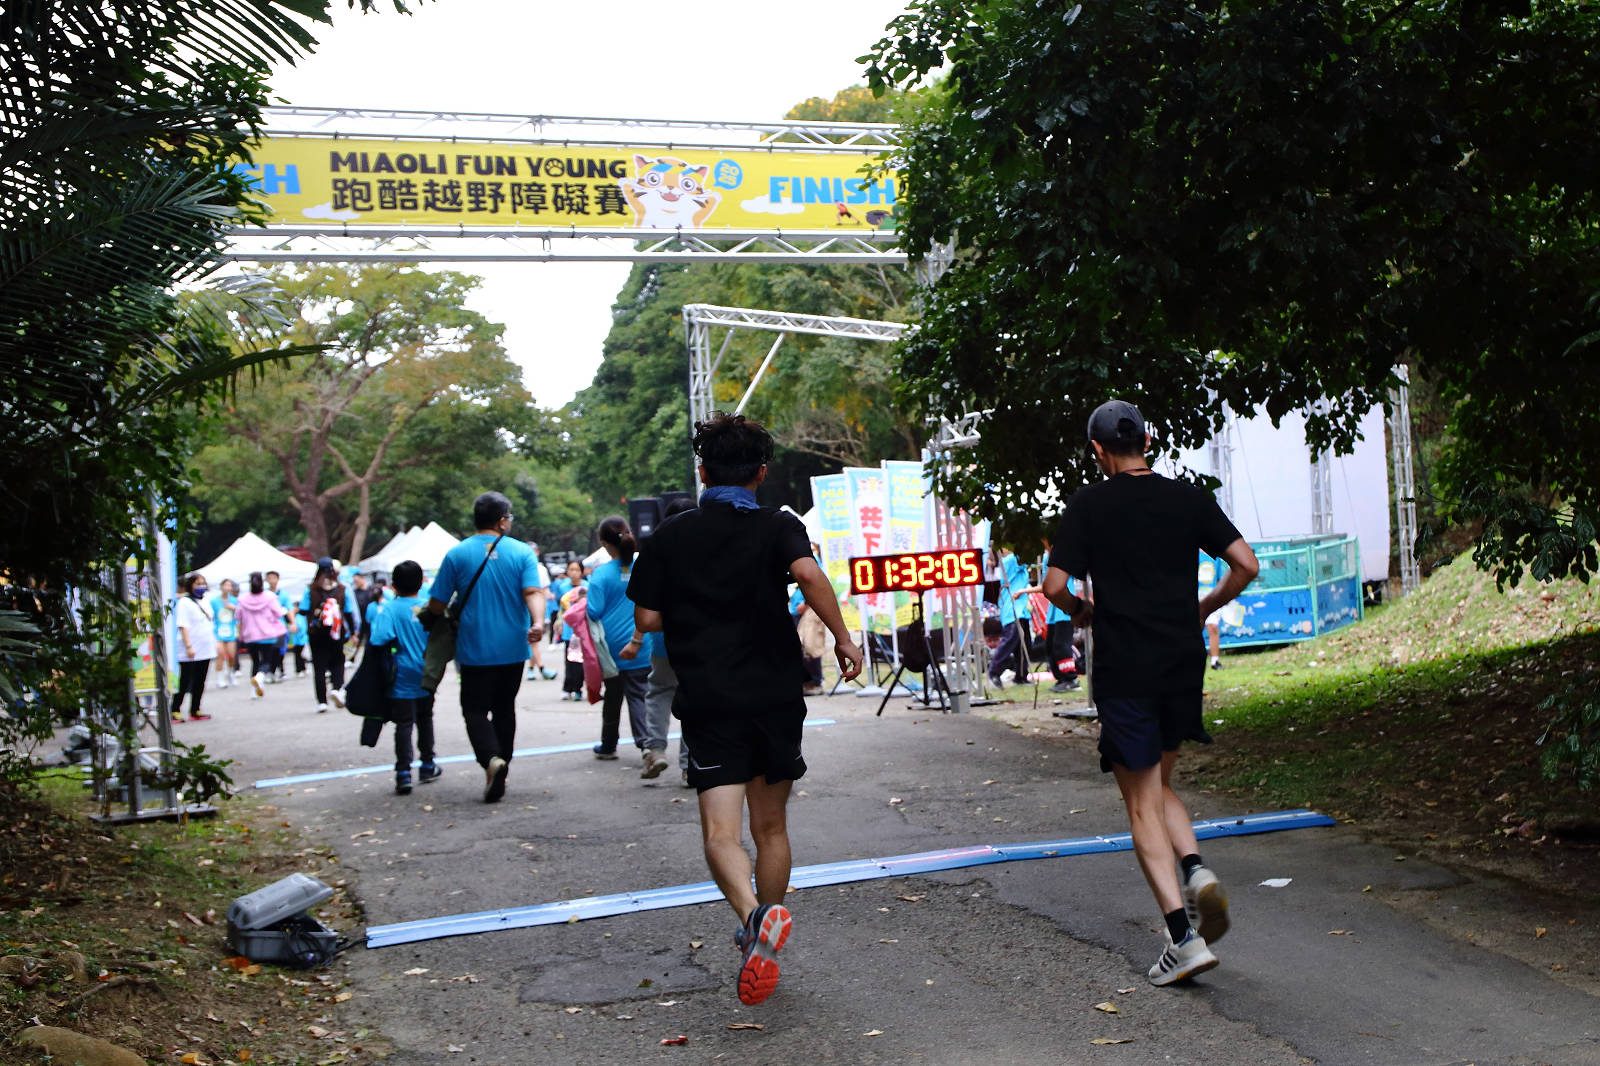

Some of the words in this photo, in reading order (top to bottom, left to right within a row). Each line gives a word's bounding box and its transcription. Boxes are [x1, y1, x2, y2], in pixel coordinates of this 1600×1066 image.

[330, 151, 448, 174] MIAOLI
[456, 154, 518, 176] FUN
[525, 156, 627, 178] YOUNG
[332, 177, 628, 216] 跑酷越野障礙賽
[769, 176, 896, 205] FINISH
[854, 552, 979, 591] 01:32:05
